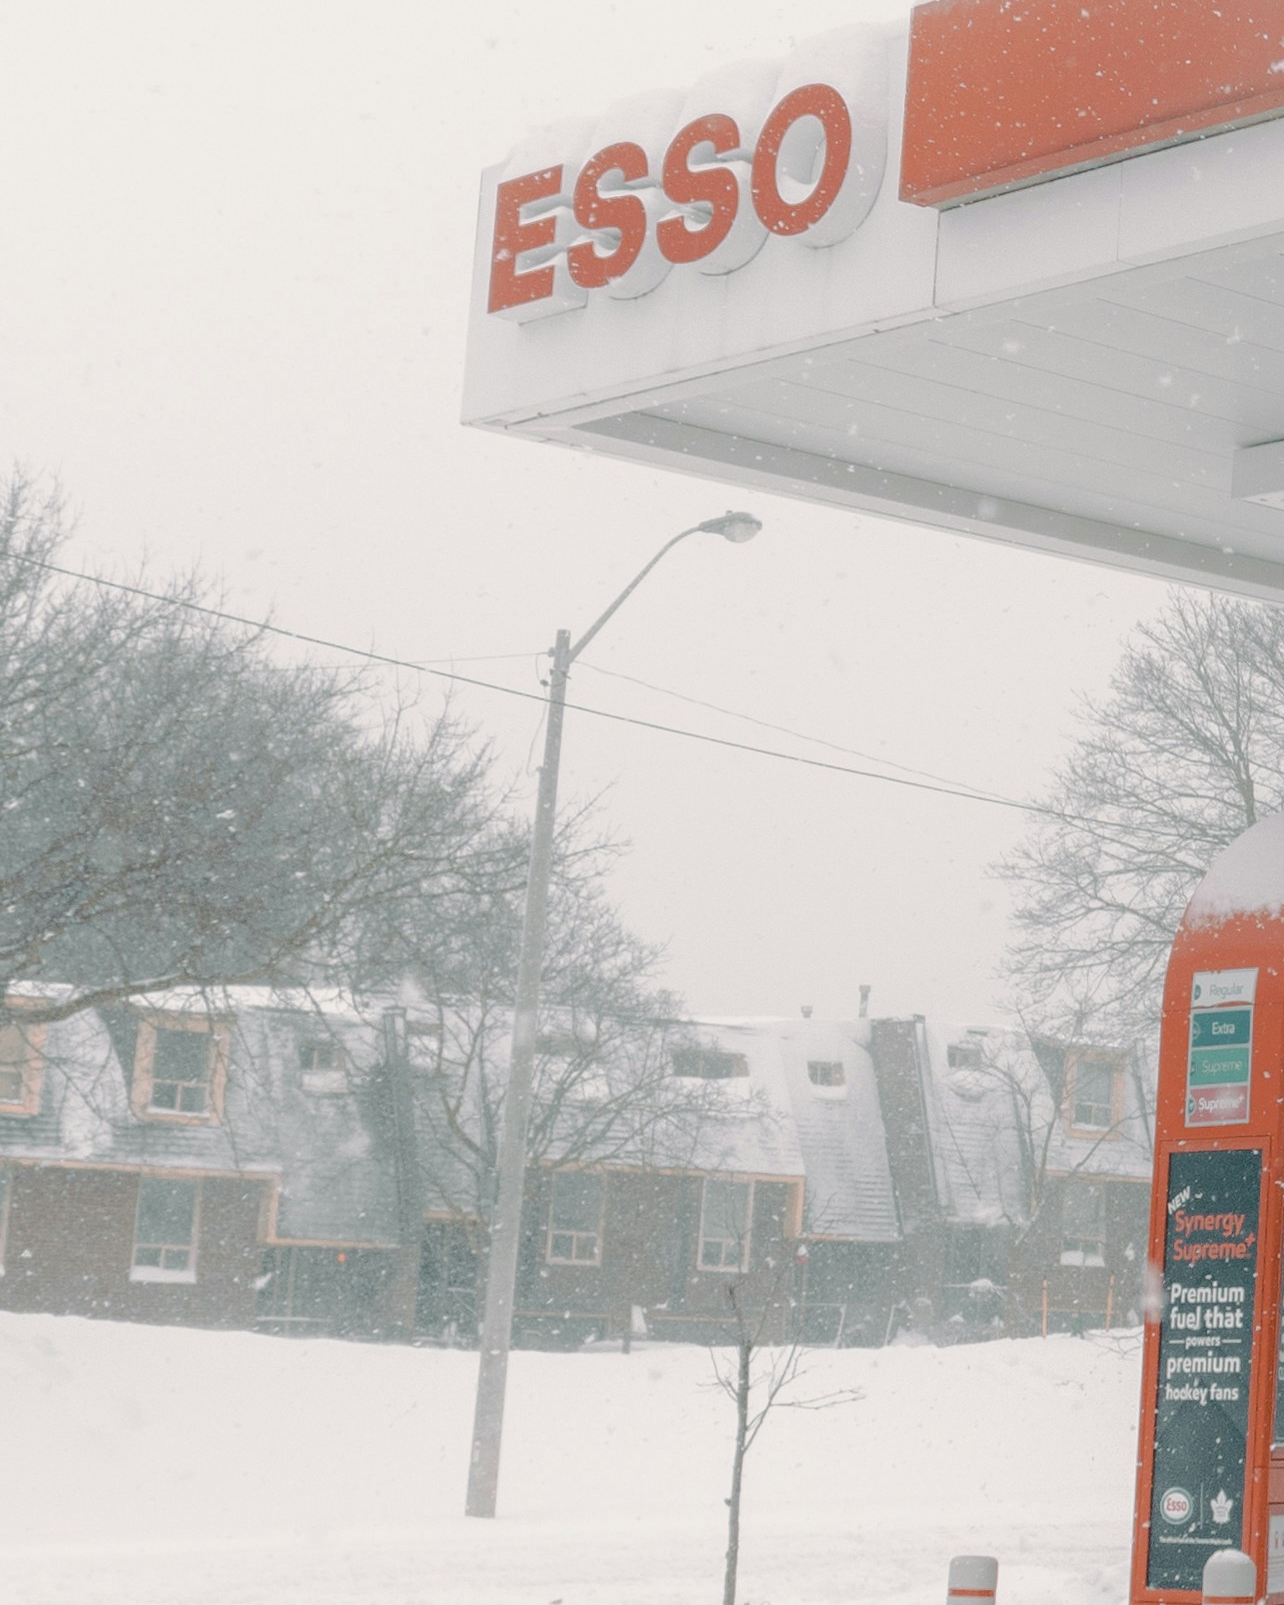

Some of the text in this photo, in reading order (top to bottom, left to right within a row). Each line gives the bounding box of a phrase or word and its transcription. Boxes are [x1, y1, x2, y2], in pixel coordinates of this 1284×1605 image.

[487, 82, 852, 314] ESSO
[1209, 982, 1244, 1000] Regular
[1211, 1021, 1236, 1036] Extra
[1202, 1059, 1243, 1075] Supreme
[1167, 1185, 1191, 1215] NEW
[1174, 1209, 1246, 1238] Synergy
[1169, 1281, 1245, 1304] Premium
[1170, 1306, 1243, 1330] fuel that
[1185, 1336, 1221, 1350] powers
[1166, 1350, 1241, 1380] premium
[1165, 1382, 1239, 1406] hockey fans
[1166, 1498, 1187, 1512] Esso
